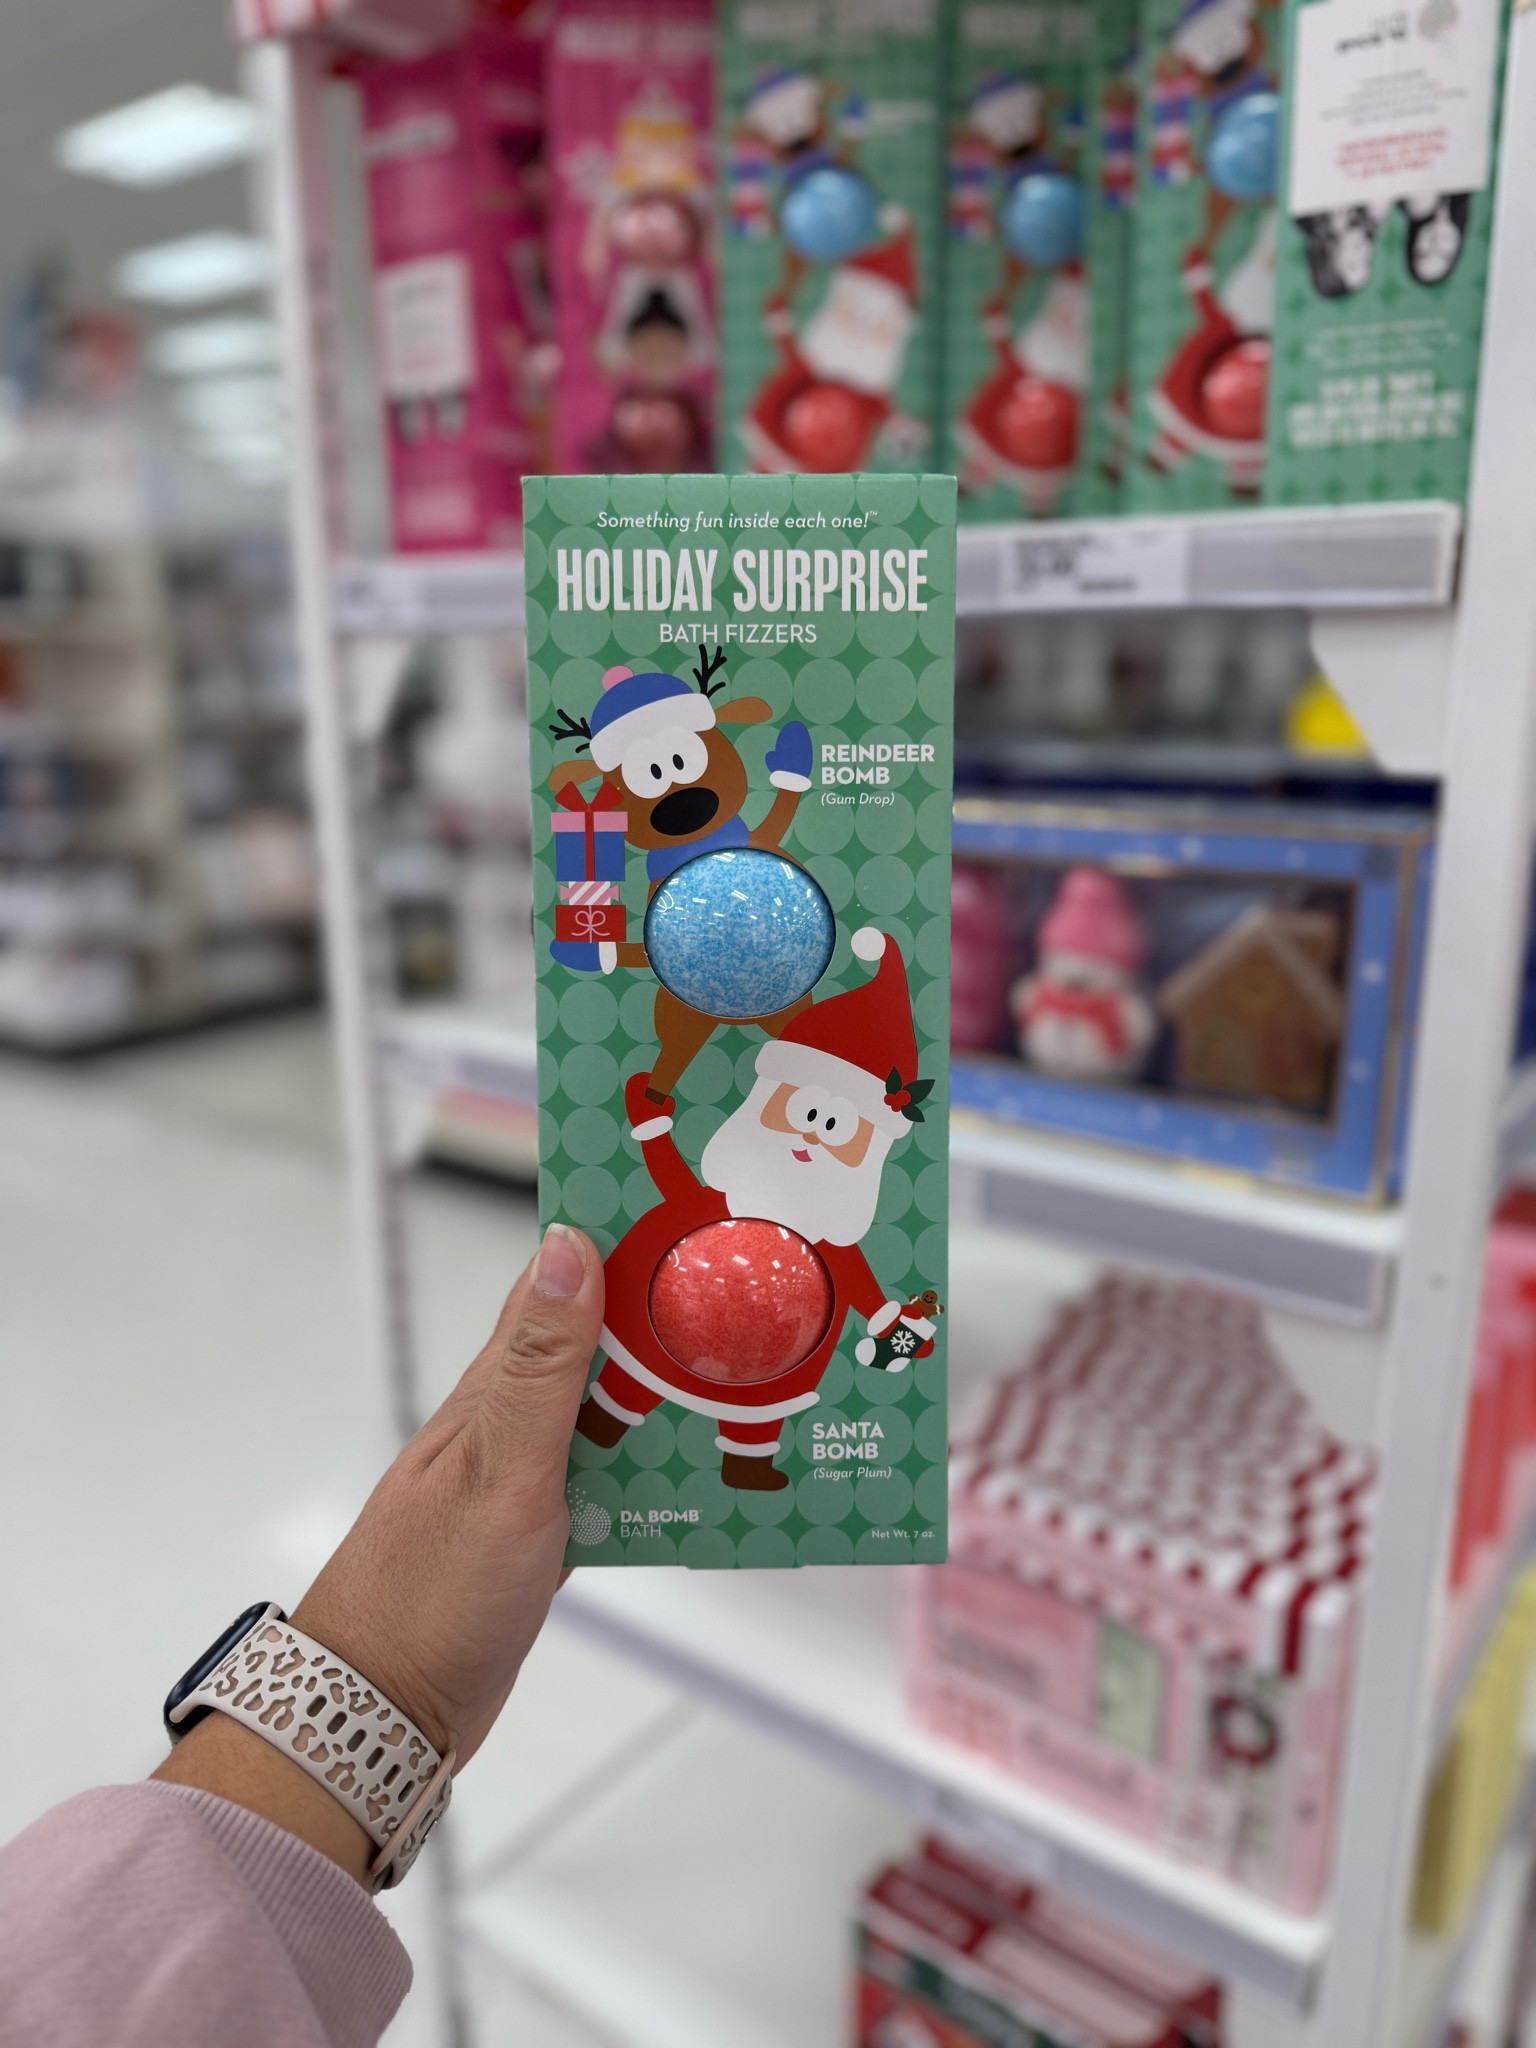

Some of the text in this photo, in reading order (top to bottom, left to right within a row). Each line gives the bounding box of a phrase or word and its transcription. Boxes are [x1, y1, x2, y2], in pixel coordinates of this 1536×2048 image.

[597, 511, 690, 532] Something
[695, 511, 723, 532] fun
[728, 511, 780, 529] inside
[784, 511, 826, 529] each
[557, 548, 928, 613] HOLIDAY SURPRISE
[660, 624, 817, 643] BATH FIZZERS
[821, 744, 935, 763] REINDEER
[821, 766, 890, 785] BOMB
[821, 793, 895, 807] (Gum Drop)
[812, 1421, 885, 1439] SANTA
[812, 1442, 879, 1460] BOMB
[813, 1466, 892, 1481] (Sugar Plum)
[620, 1510, 644, 1523] DA
[620, 1524, 662, 1538] BATH
[872, 1529, 936, 1538] Net Wt. 7 oz.
